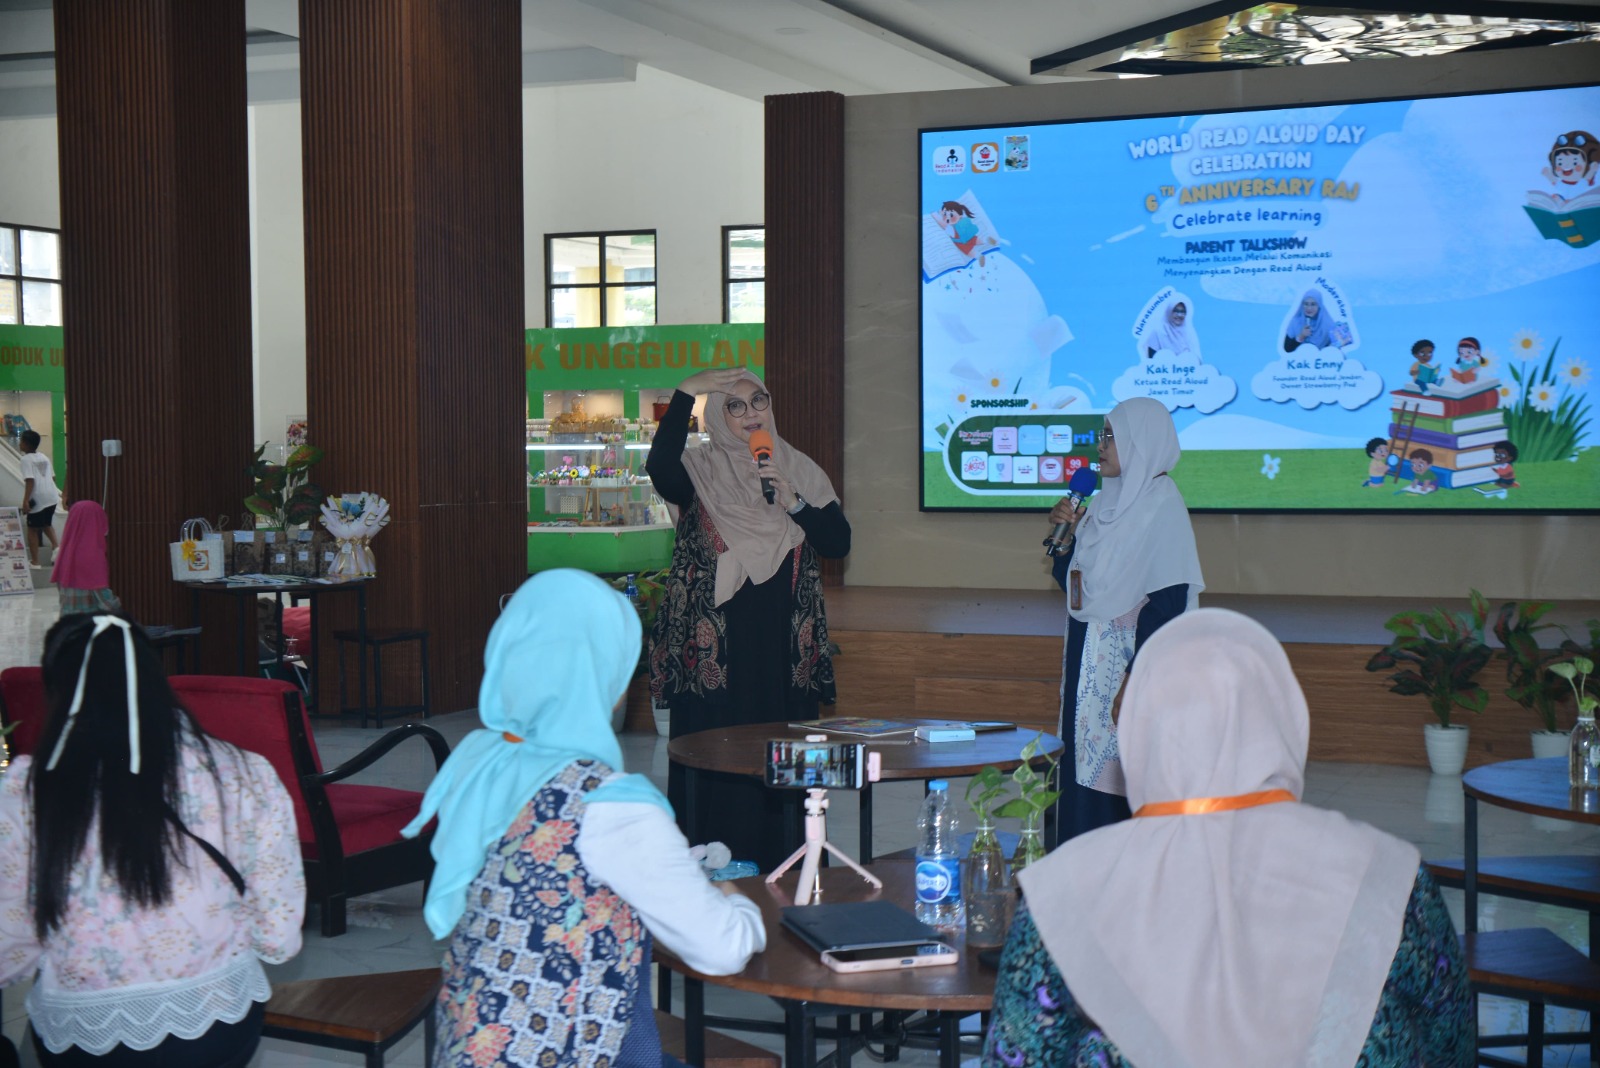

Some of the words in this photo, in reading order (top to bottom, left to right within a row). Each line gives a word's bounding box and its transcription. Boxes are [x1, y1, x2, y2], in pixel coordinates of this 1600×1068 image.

[1128, 133, 1193, 159] WORLD
[1200, 127, 1249, 149] READ
[1255, 125, 1318, 144] ALOUD
[1325, 124, 1366, 144] DAY
[1190, 151, 1312, 175] CELEBRATION
[1179, 178, 1315, 205] ANNIVERSARY
[1321, 179, 1360, 201] RAJ
[1172, 208, 1252, 230] Celebrate
[1257, 207, 1322, 226] learning
[1185, 239, 1235, 254] PARENT
[1239, 237, 1308, 252] TALKSHOW
[1157, 256, 1210, 266] Membangun
[1213, 255, 1243, 263] Ikatan
[1245, 253, 1278, 262] Melalui
[1280, 251, 1333, 261] Komunikasi
[1164, 268, 1231, 279] Menyenangkan
[1234, 266, 1267, 276] Dengan
[1270, 264, 1293, 273] Read
[1295, 263, 1323, 272] Aloud
[1315, 277, 1347, 317] Moderator
[1134, 289, 1173, 336] Narasumber
[559, 340, 765, 370] UNGGULAN
[1146, 364, 1169, 375] Kak
[1172, 363, 1196, 378] Inge
[1287, 359, 1310, 371] Kak
[1314, 358, 1344, 373] Enny
[1134, 378, 1159, 387] Ketua
[1161, 377, 1182, 386] Read
[1184, 376, 1209, 385] Aloud
[1147, 388, 1169, 396] Jawa
[1171, 387, 1195, 396] Timur
[970, 399, 1029, 408] SPONSORSHIP
[1074, 430, 1095, 445] rri
